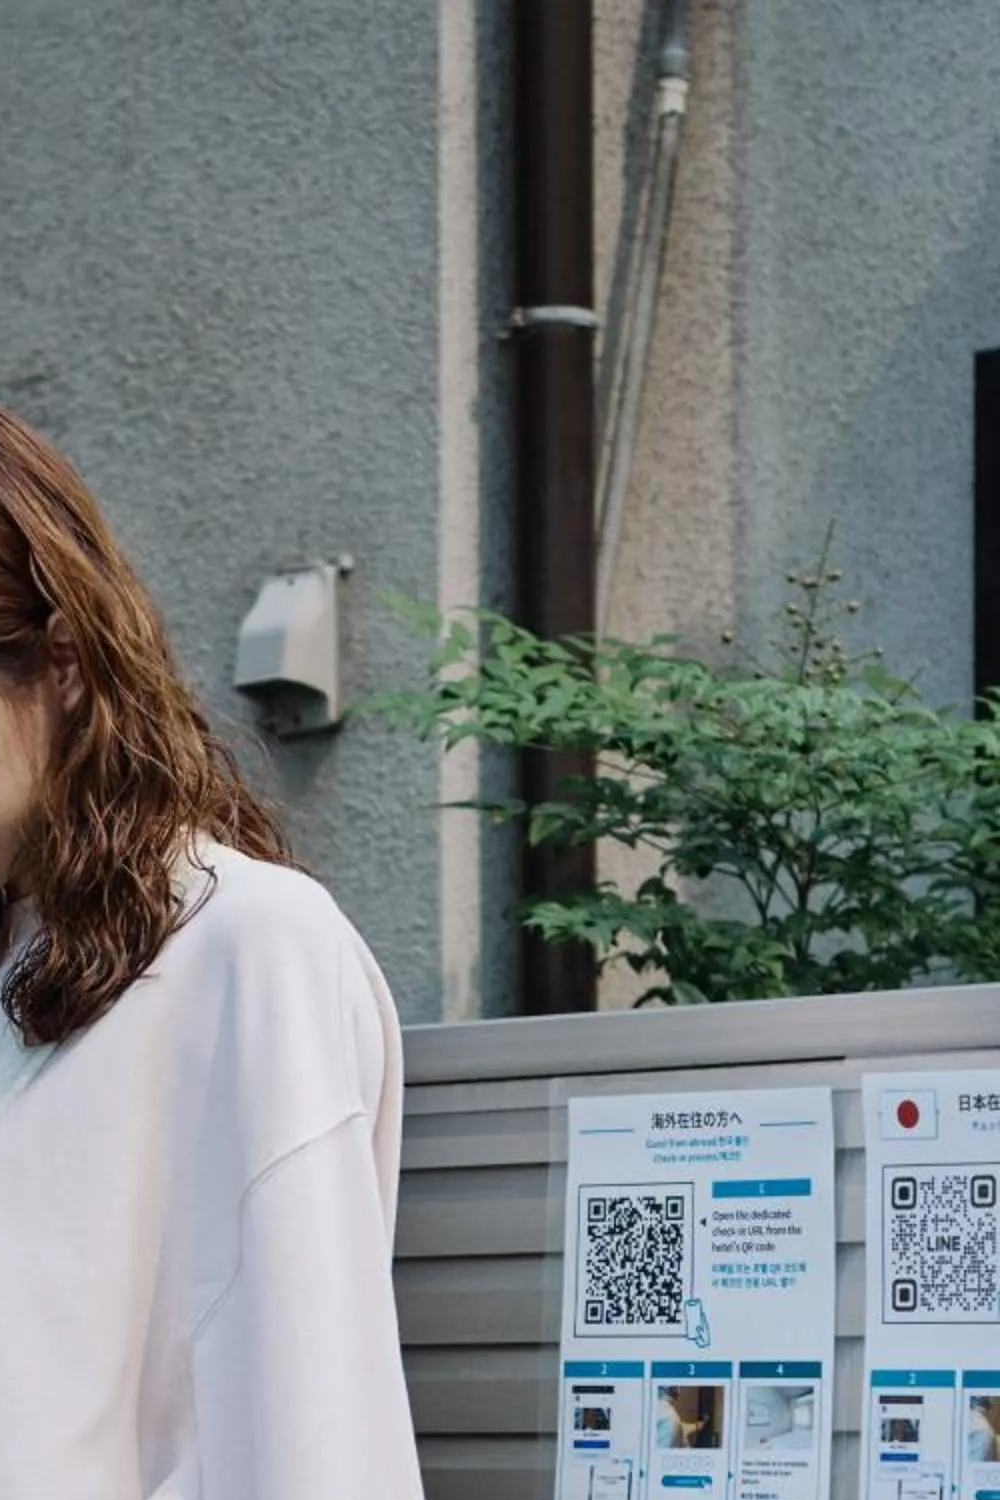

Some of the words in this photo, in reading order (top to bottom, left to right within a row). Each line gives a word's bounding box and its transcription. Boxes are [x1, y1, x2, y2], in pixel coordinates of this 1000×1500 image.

[651, 1111, 743, 1130] 海外在住の方へ
[712, 1210, 734, 1222] Open
[735, 1210, 749, 1220] the
[750, 1209, 792, 1220] dedicated
[747, 1226, 763, 1236] URL
[766, 1226, 787, 1235] from
[787, 1225, 802, 1235] the
[741, 1241, 754, 1254] QR
[755, 1241, 776, 1252] code
[927, 1236, 961, 1252] LINE
[776, 1363, 784, 1376] 4
